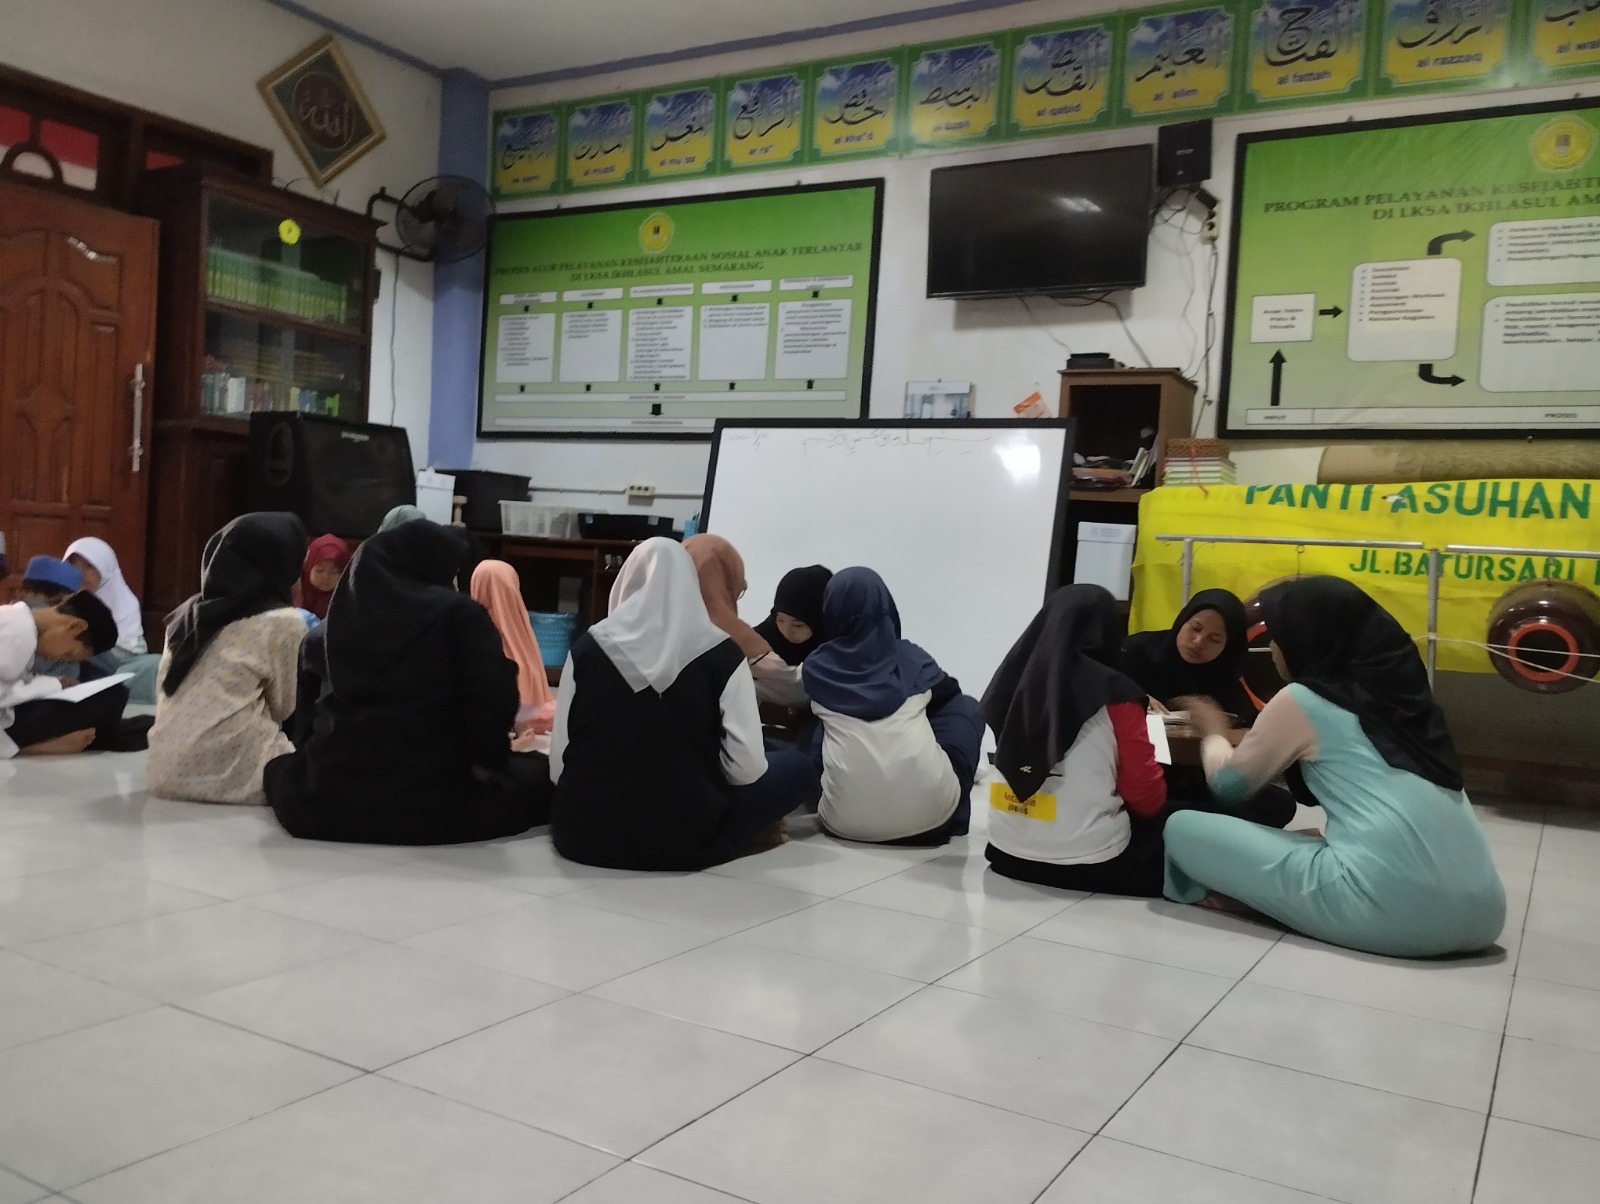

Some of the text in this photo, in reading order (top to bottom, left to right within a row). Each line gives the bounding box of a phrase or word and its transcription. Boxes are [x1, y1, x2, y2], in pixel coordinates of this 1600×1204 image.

[1264, 195, 1360, 213] PROGRAM
[1365, 186, 1485, 206] PELAYANAN
[1373, 208, 1394, 220] DI
[1400, 204, 1451, 218] LKSA
[1245, 481, 1591, 519] PANTI ASUHAN
